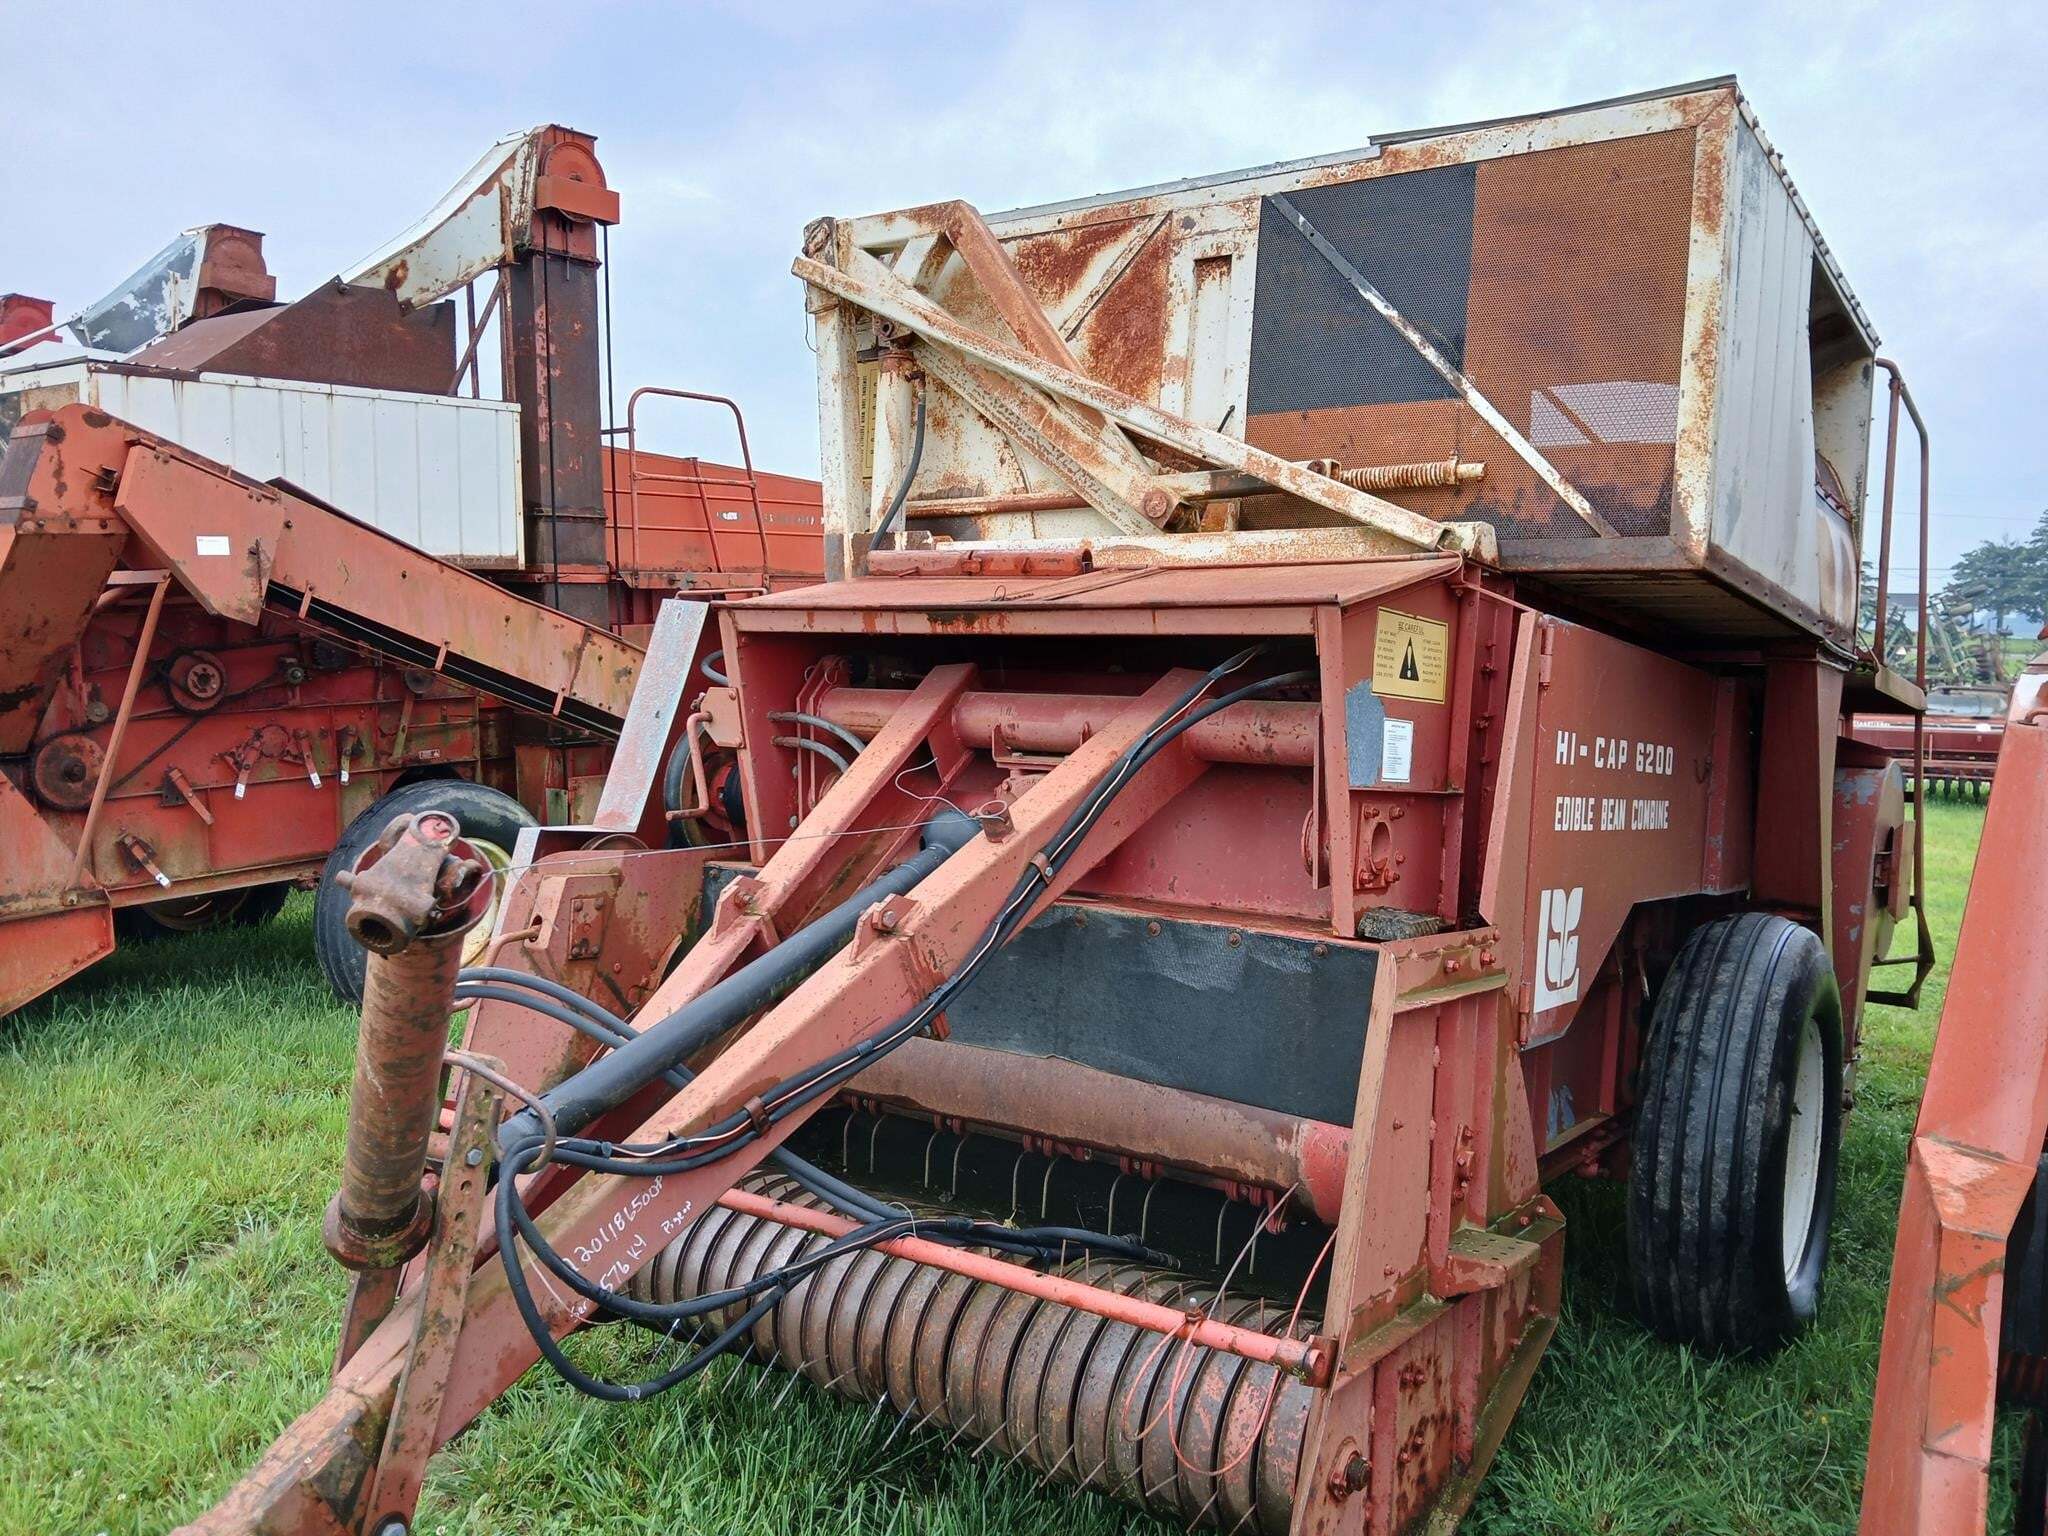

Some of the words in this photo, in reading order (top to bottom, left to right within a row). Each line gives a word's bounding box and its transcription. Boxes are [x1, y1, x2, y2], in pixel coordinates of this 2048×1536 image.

[1636, 742, 1673, 775] 6200
[1555, 796, 1595, 831] EDIBLE
[1601, 798, 1626, 831] BEAN
[1631, 799, 1669, 830] COMBINE
